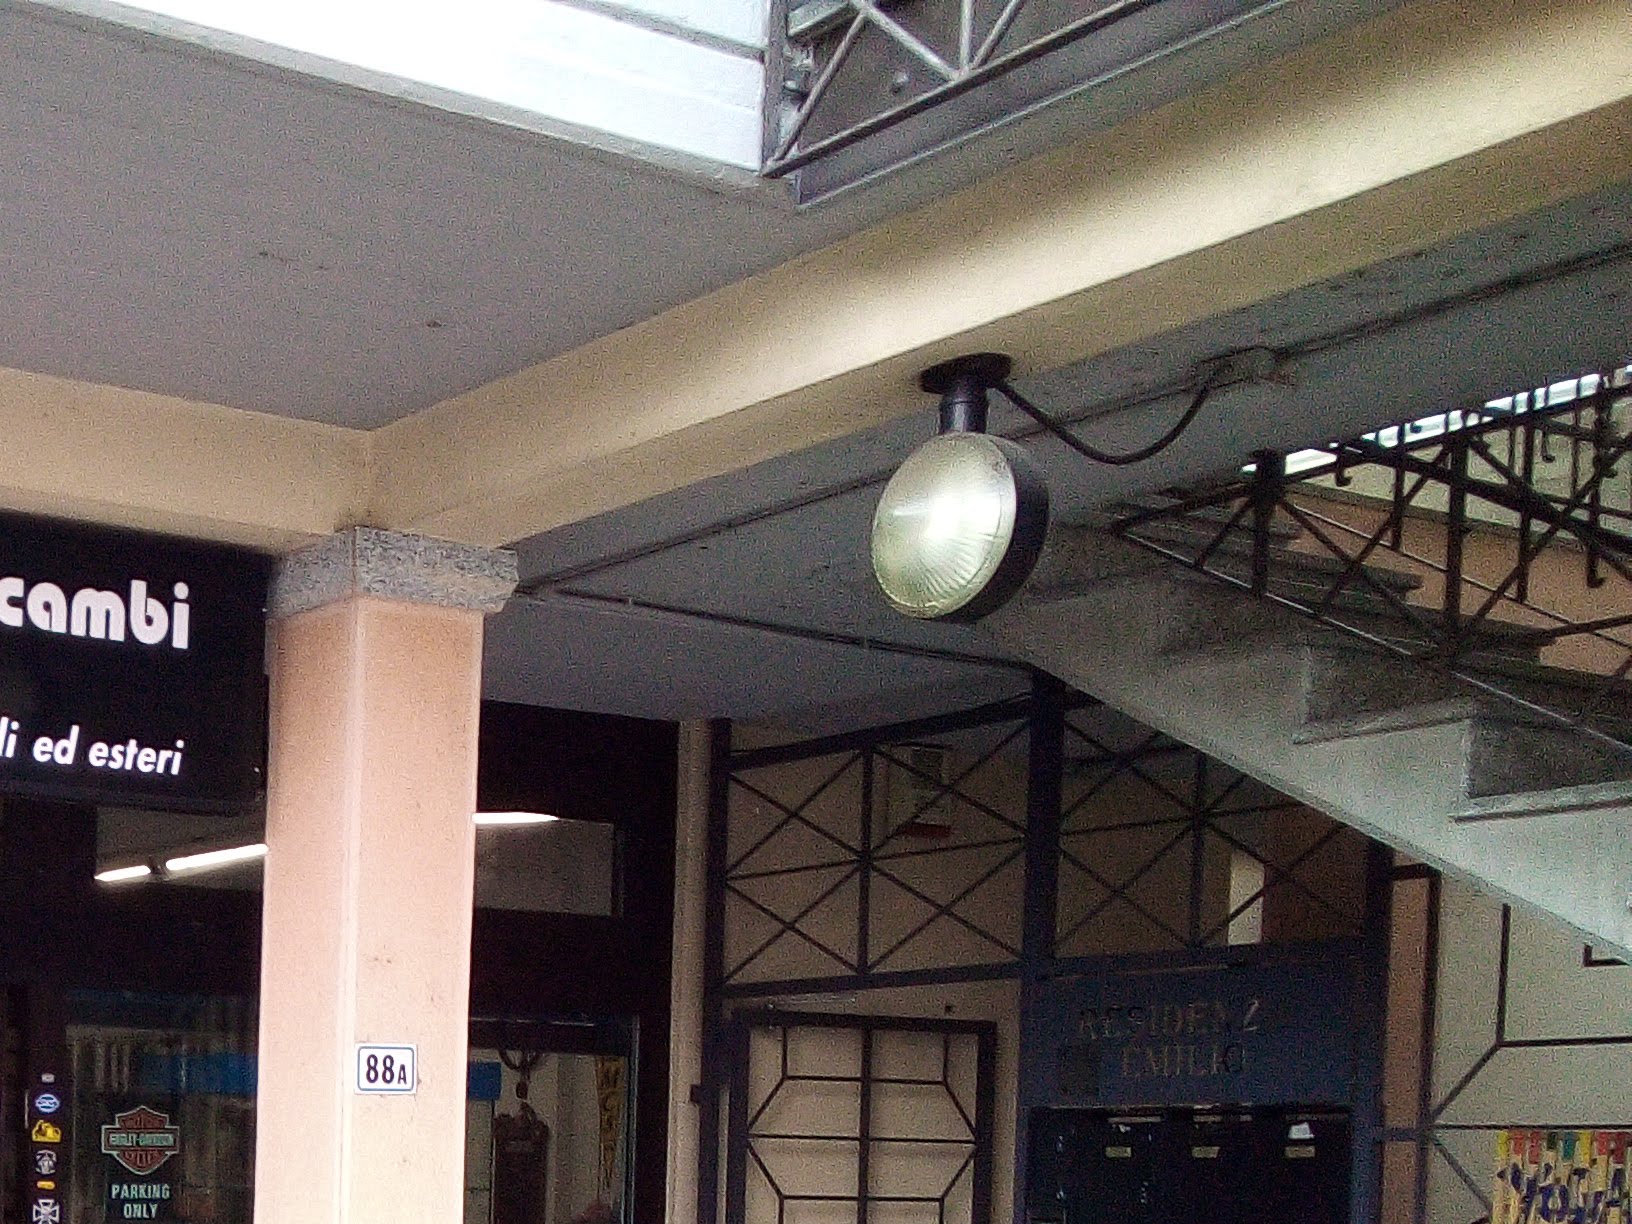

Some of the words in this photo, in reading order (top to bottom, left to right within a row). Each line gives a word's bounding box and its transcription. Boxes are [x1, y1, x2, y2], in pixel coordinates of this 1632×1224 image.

[32, 725, 80, 765] ed
[88, 739, 185, 776] esteri
[111, 1183, 171, 1200] PARKING
[123, 1203, 158, 1218] ONLY
